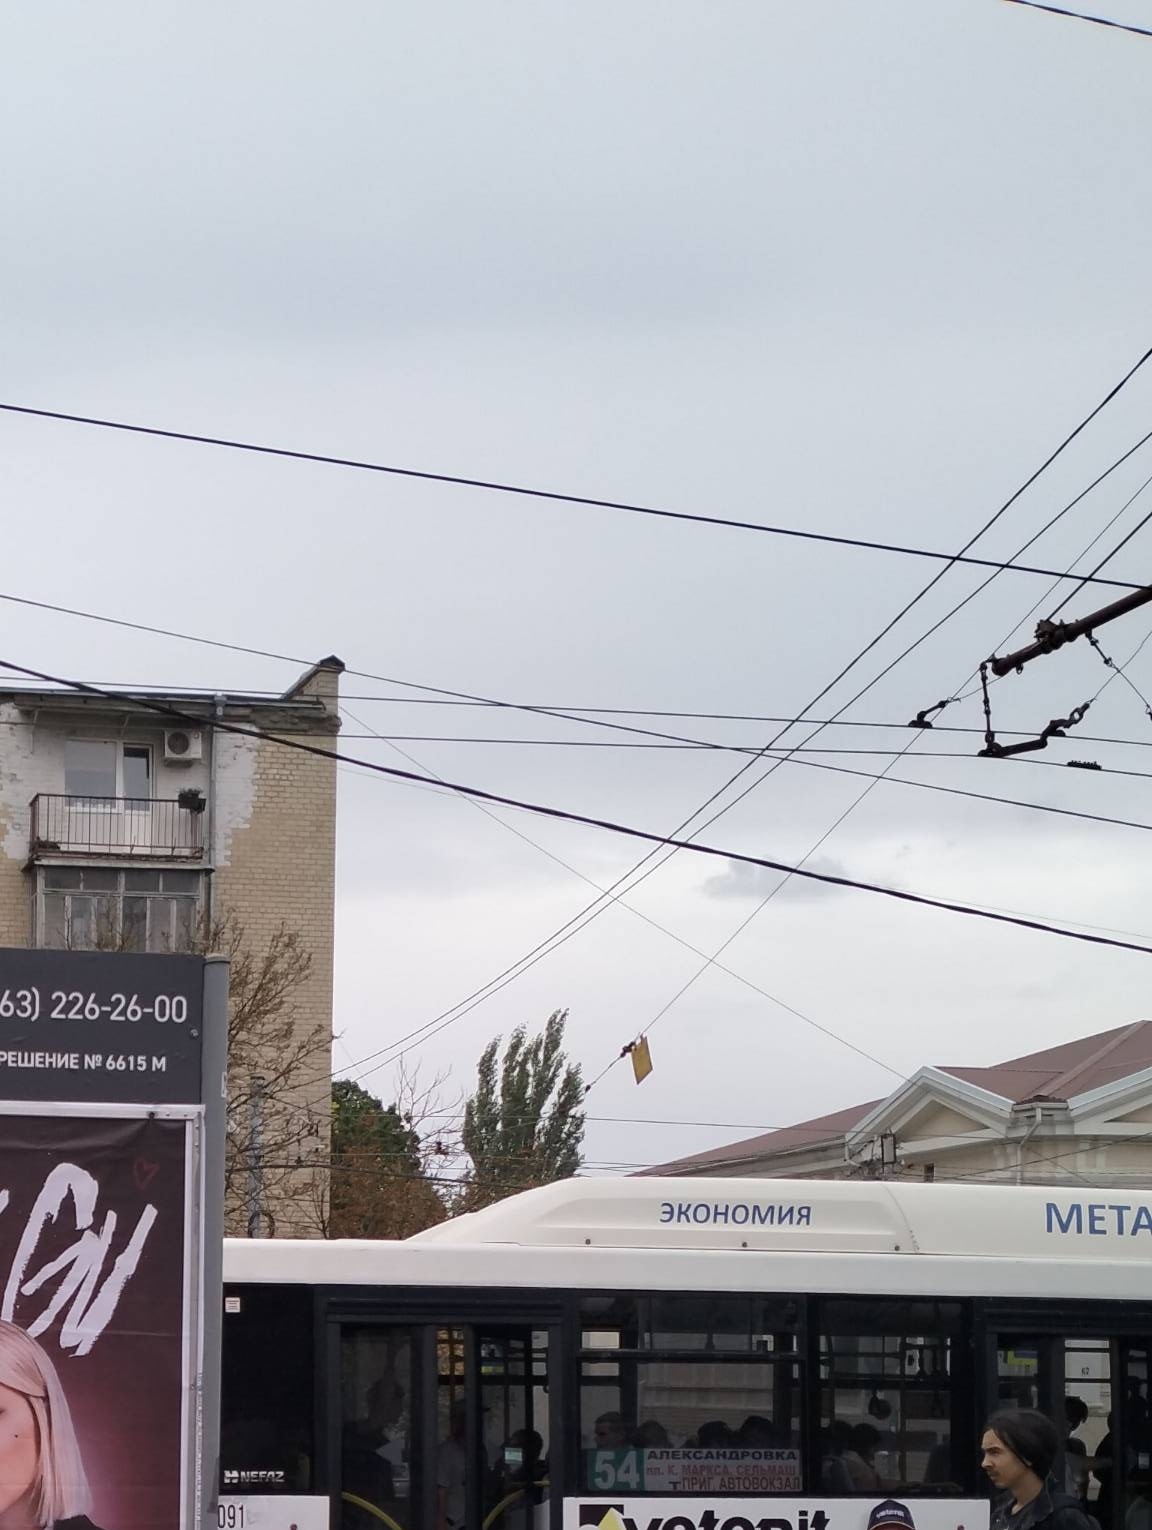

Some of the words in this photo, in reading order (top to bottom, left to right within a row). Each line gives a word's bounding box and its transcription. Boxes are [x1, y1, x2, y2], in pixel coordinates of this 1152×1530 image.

[51, 993, 187, 1024] 226-26-00
[105, 1053, 146, 1072] 6615
[660, 1201, 812, 1227] ЭКОНОМИЯ
[647, 1450, 797, 1461] АЛЕКСАНДРОВКА
[240, 1470, 285, 1483] NEFAZ
[594, 1450, 641, 1490] 54
[719, 1477, 801, 1490] АВТОВОКЗАЛ
